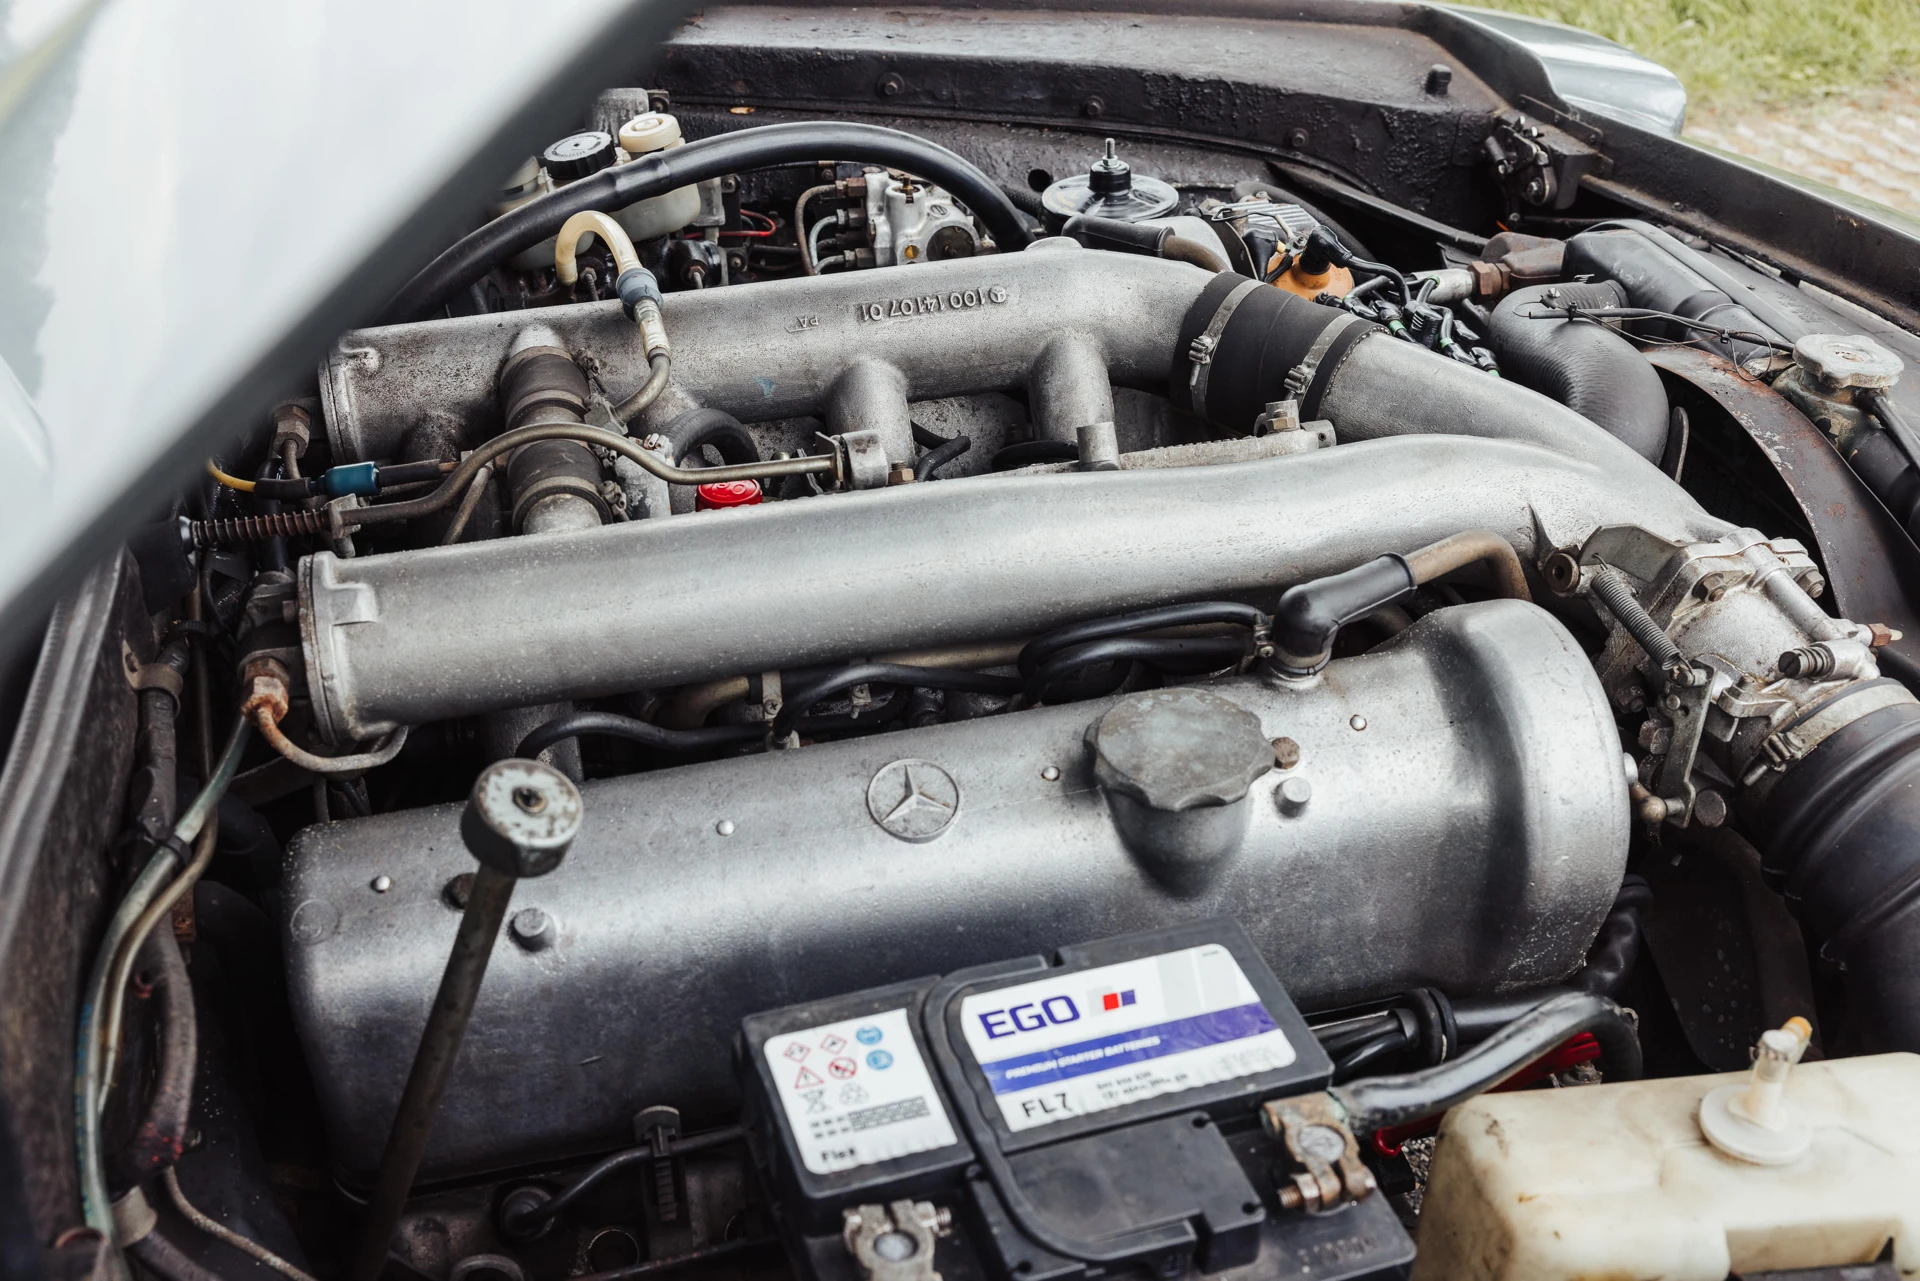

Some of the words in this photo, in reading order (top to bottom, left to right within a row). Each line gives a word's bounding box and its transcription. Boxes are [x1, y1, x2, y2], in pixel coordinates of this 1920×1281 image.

[949, 287, 985, 309] 100
[861, 303, 883, 321] 01
[978, 995, 1081, 1039] EGO
[1005, 1060, 1058, 1079] PREMIUM
[1058, 1049, 1104, 1068] STARTER
[1104, 1035, 1161, 1057] BATTERIES
[1021, 1092, 1070, 1119] FL7
